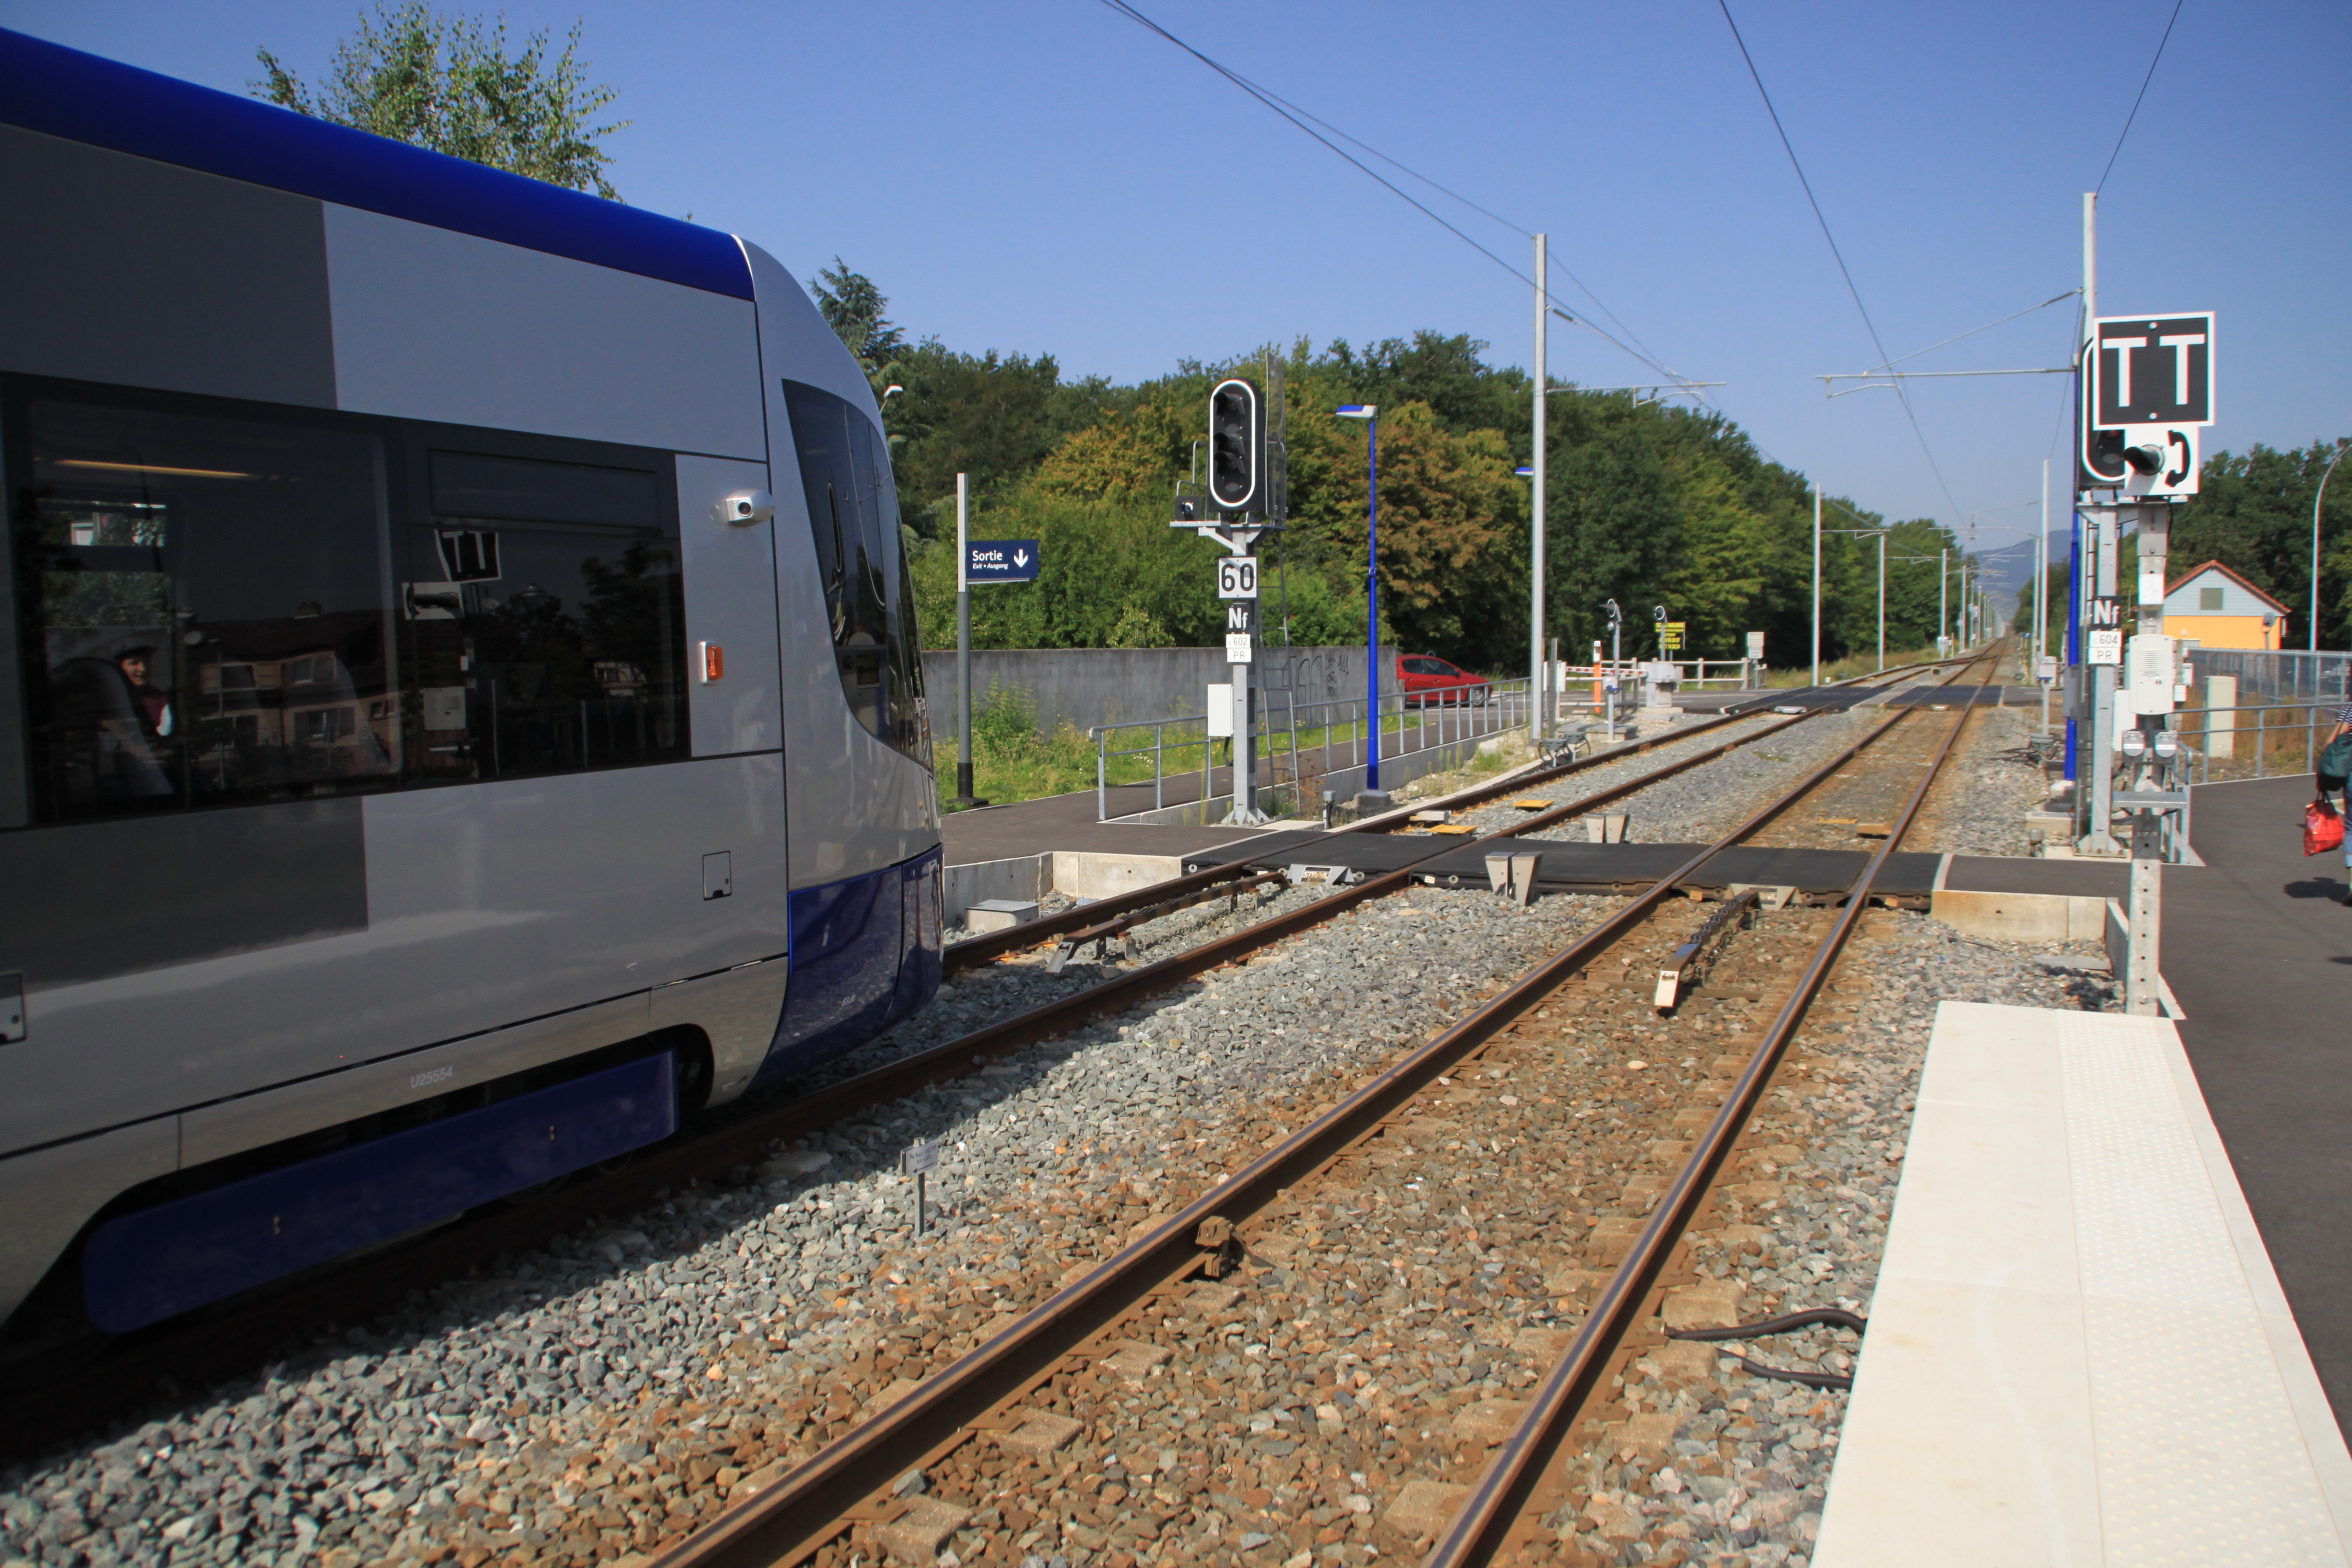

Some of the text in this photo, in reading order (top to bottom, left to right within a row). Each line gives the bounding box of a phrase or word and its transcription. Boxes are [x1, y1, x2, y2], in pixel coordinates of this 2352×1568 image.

[972, 549, 1003, 561] Sortie
[987, 562, 1009, 570] Ausgang
[1221, 563, 1255, 592] 60
[1228, 607, 1248, 629] Nf
[2094, 600, 2120, 625] Nf
[1233, 650, 1245, 660] PR
[2097, 650, 2112, 660] PR
[411, 1065, 453, 1088] U25554
